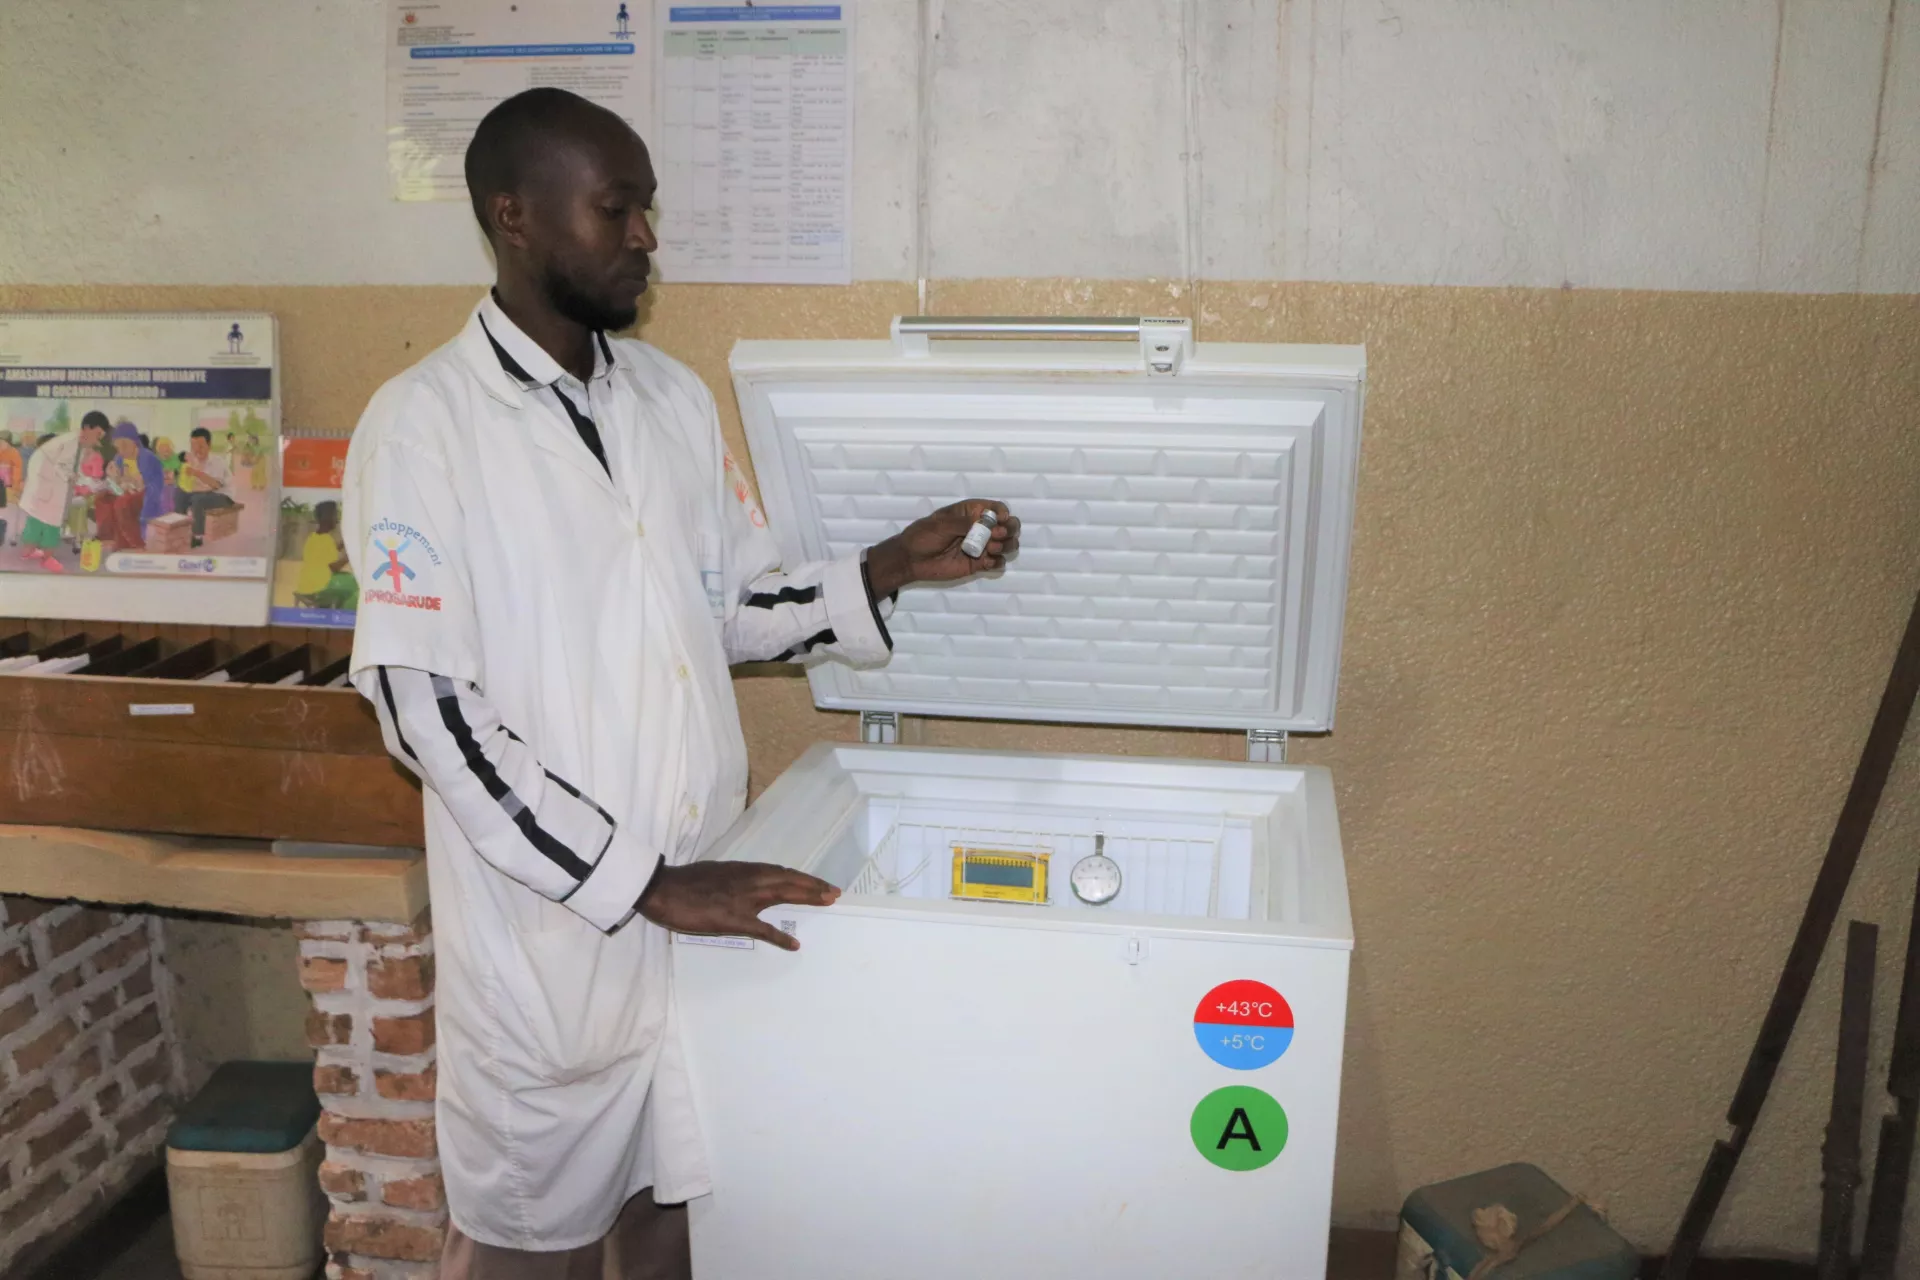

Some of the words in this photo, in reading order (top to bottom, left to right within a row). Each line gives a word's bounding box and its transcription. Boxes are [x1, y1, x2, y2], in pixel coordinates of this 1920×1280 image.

[1216, 1000, 1273, 1018] +43°C
[1220, 1034, 1265, 1051] +5°C
[1216, 1107, 1262, 1152] A
